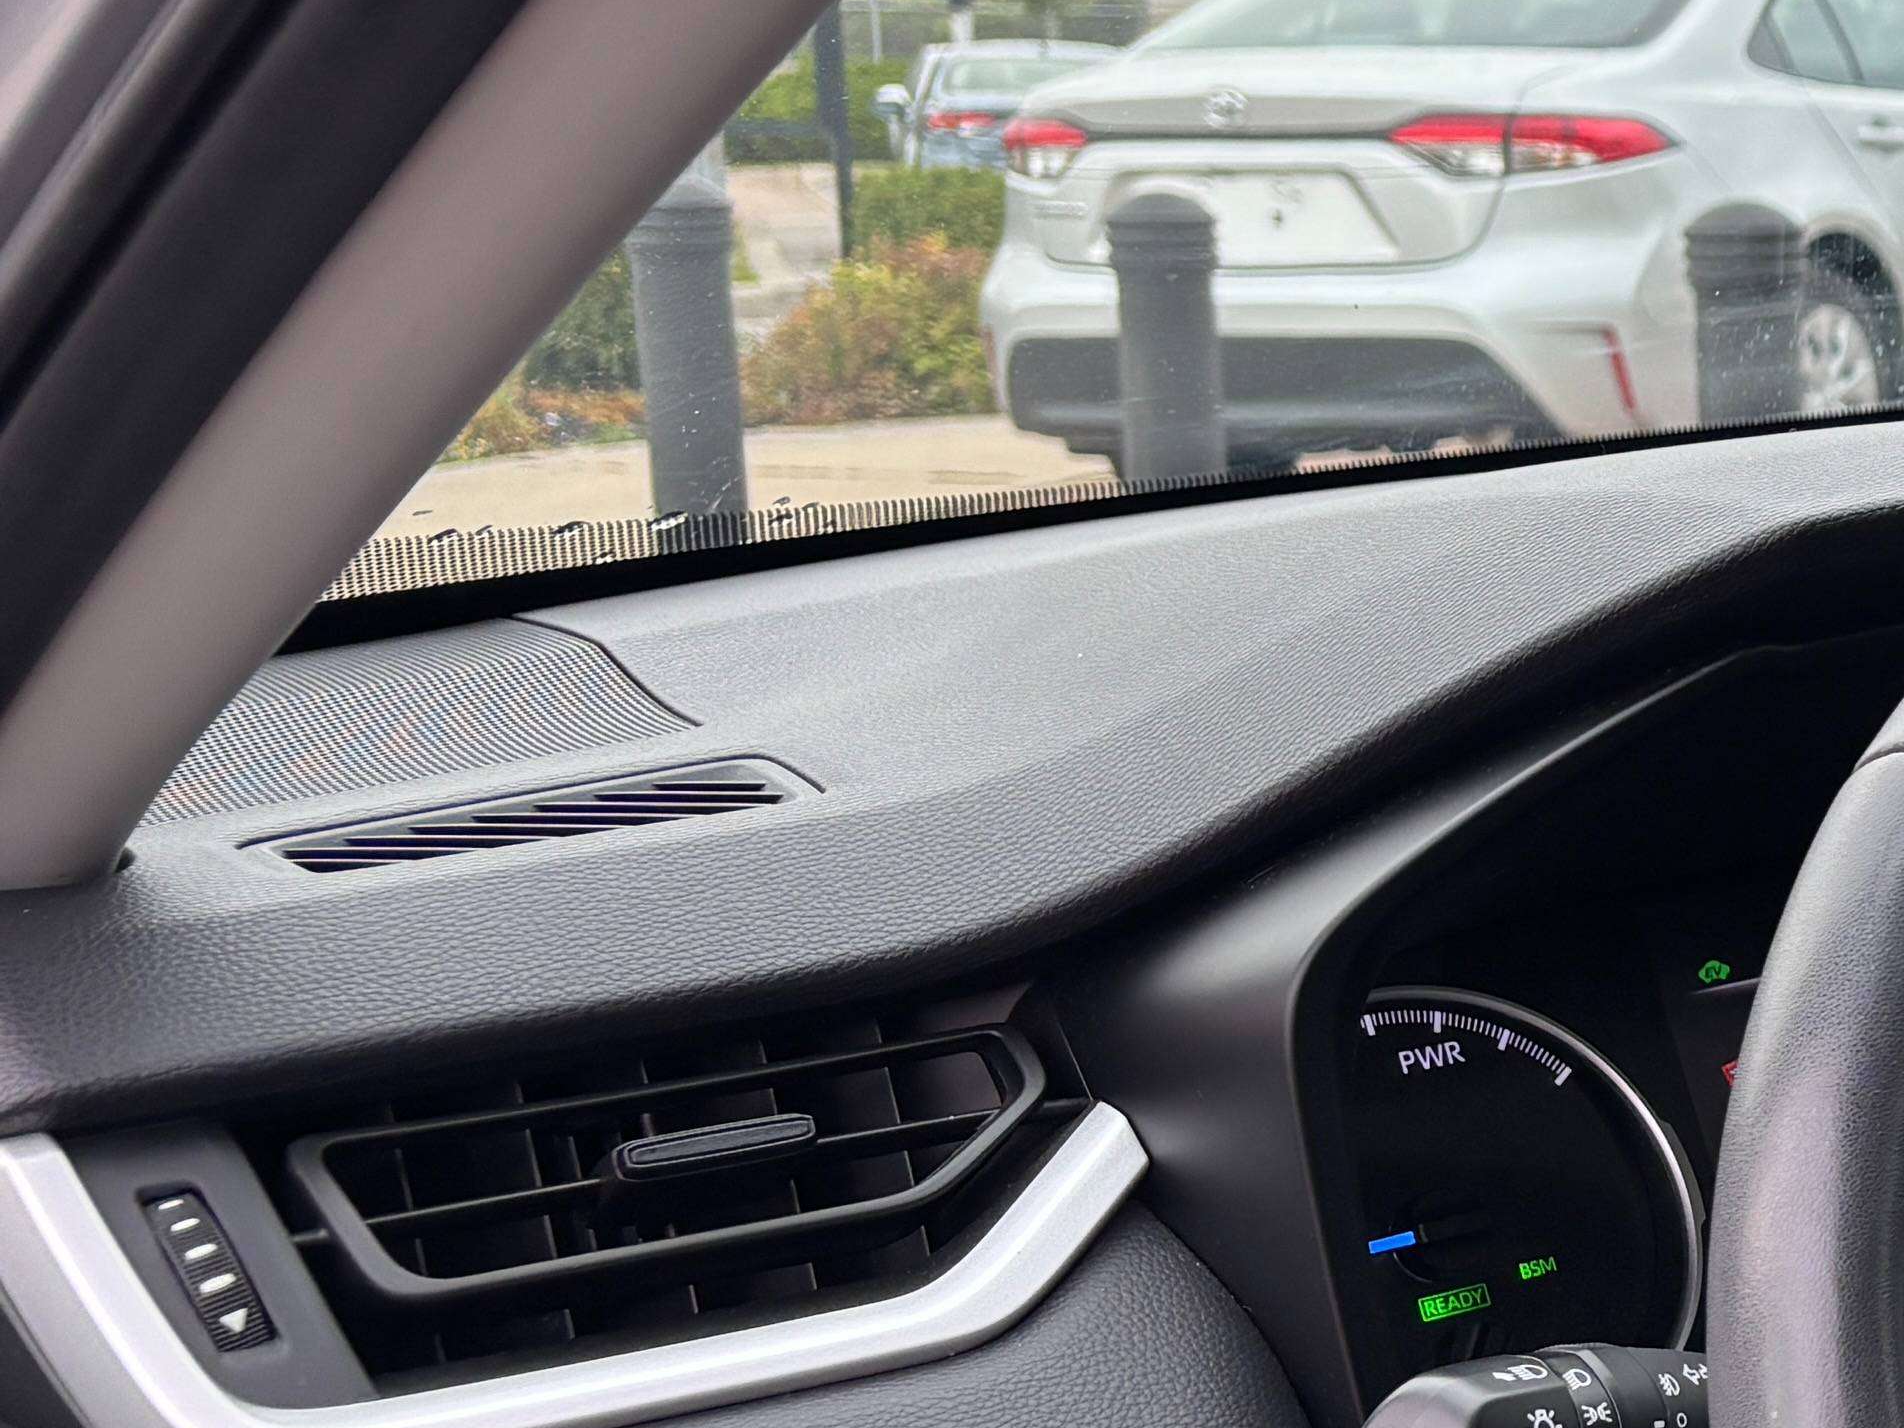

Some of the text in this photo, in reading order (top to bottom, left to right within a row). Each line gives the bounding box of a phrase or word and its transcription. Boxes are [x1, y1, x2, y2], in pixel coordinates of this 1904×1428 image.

[1398, 1041, 1466, 1074] PWR
[1519, 1256, 1557, 1280] BSM
[1424, 1288, 1483, 1317] READY
